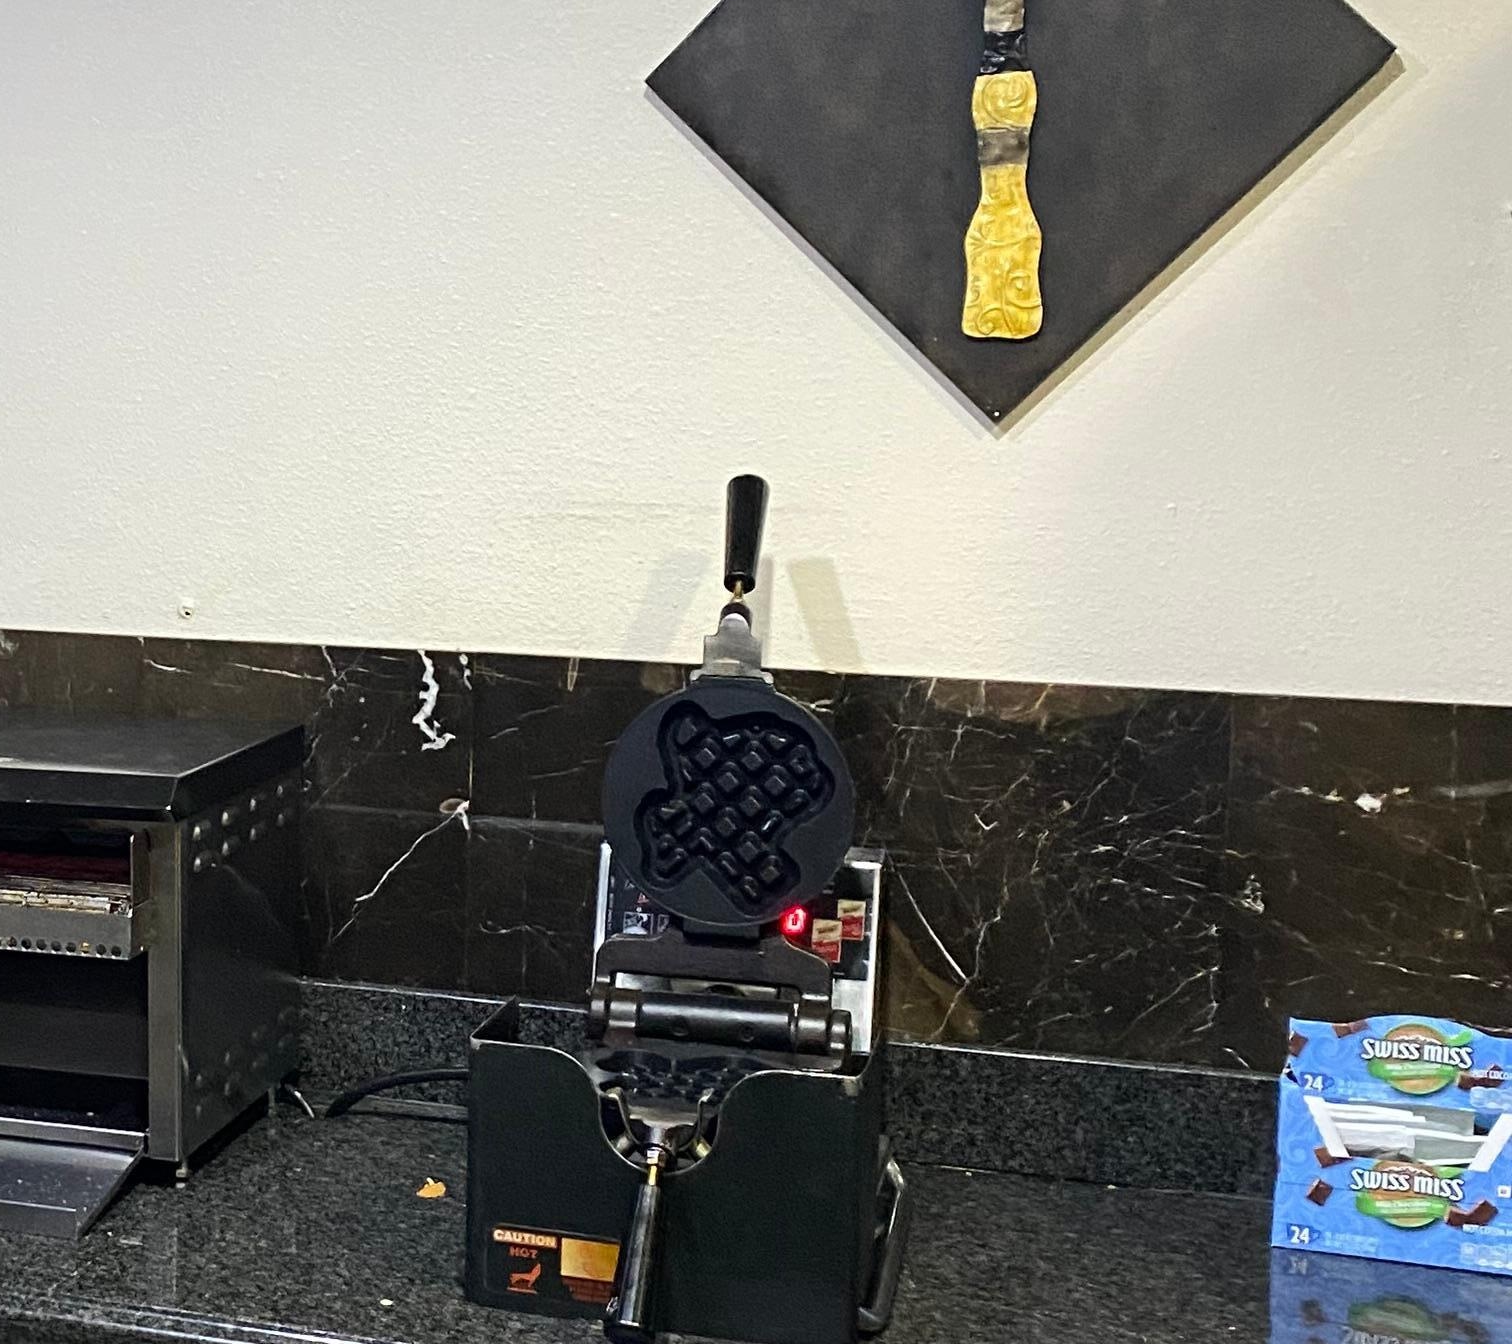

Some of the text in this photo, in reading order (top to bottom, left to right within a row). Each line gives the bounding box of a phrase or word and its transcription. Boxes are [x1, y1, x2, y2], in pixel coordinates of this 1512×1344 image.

[1303, 1074, 1324, 1092] 24
[493, 1229, 557, 1249] CAUTION
[1290, 1225, 1310, 1245] 24
[509, 1245, 538, 1259] HOT
